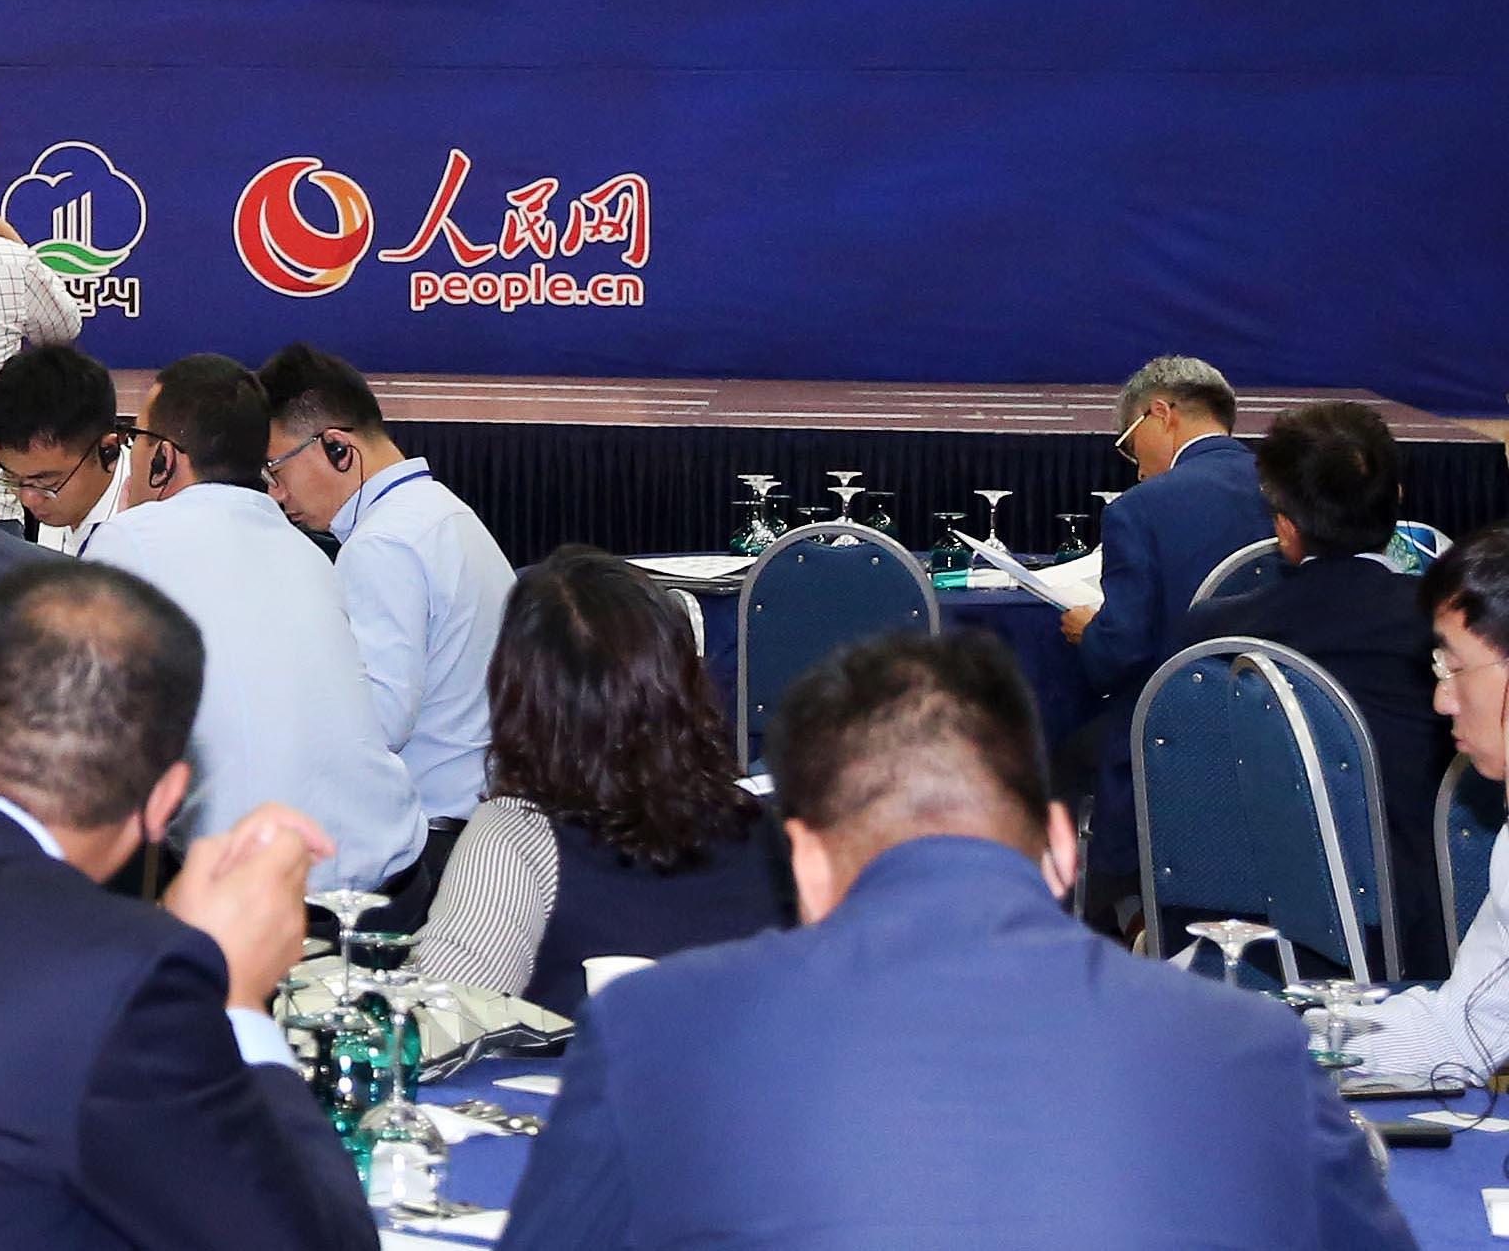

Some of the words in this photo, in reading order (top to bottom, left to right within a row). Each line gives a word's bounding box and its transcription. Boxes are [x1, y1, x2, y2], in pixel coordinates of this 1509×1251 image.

[378, 149, 650, 267] 人民网
[411, 263, 644, 312] people.cn
